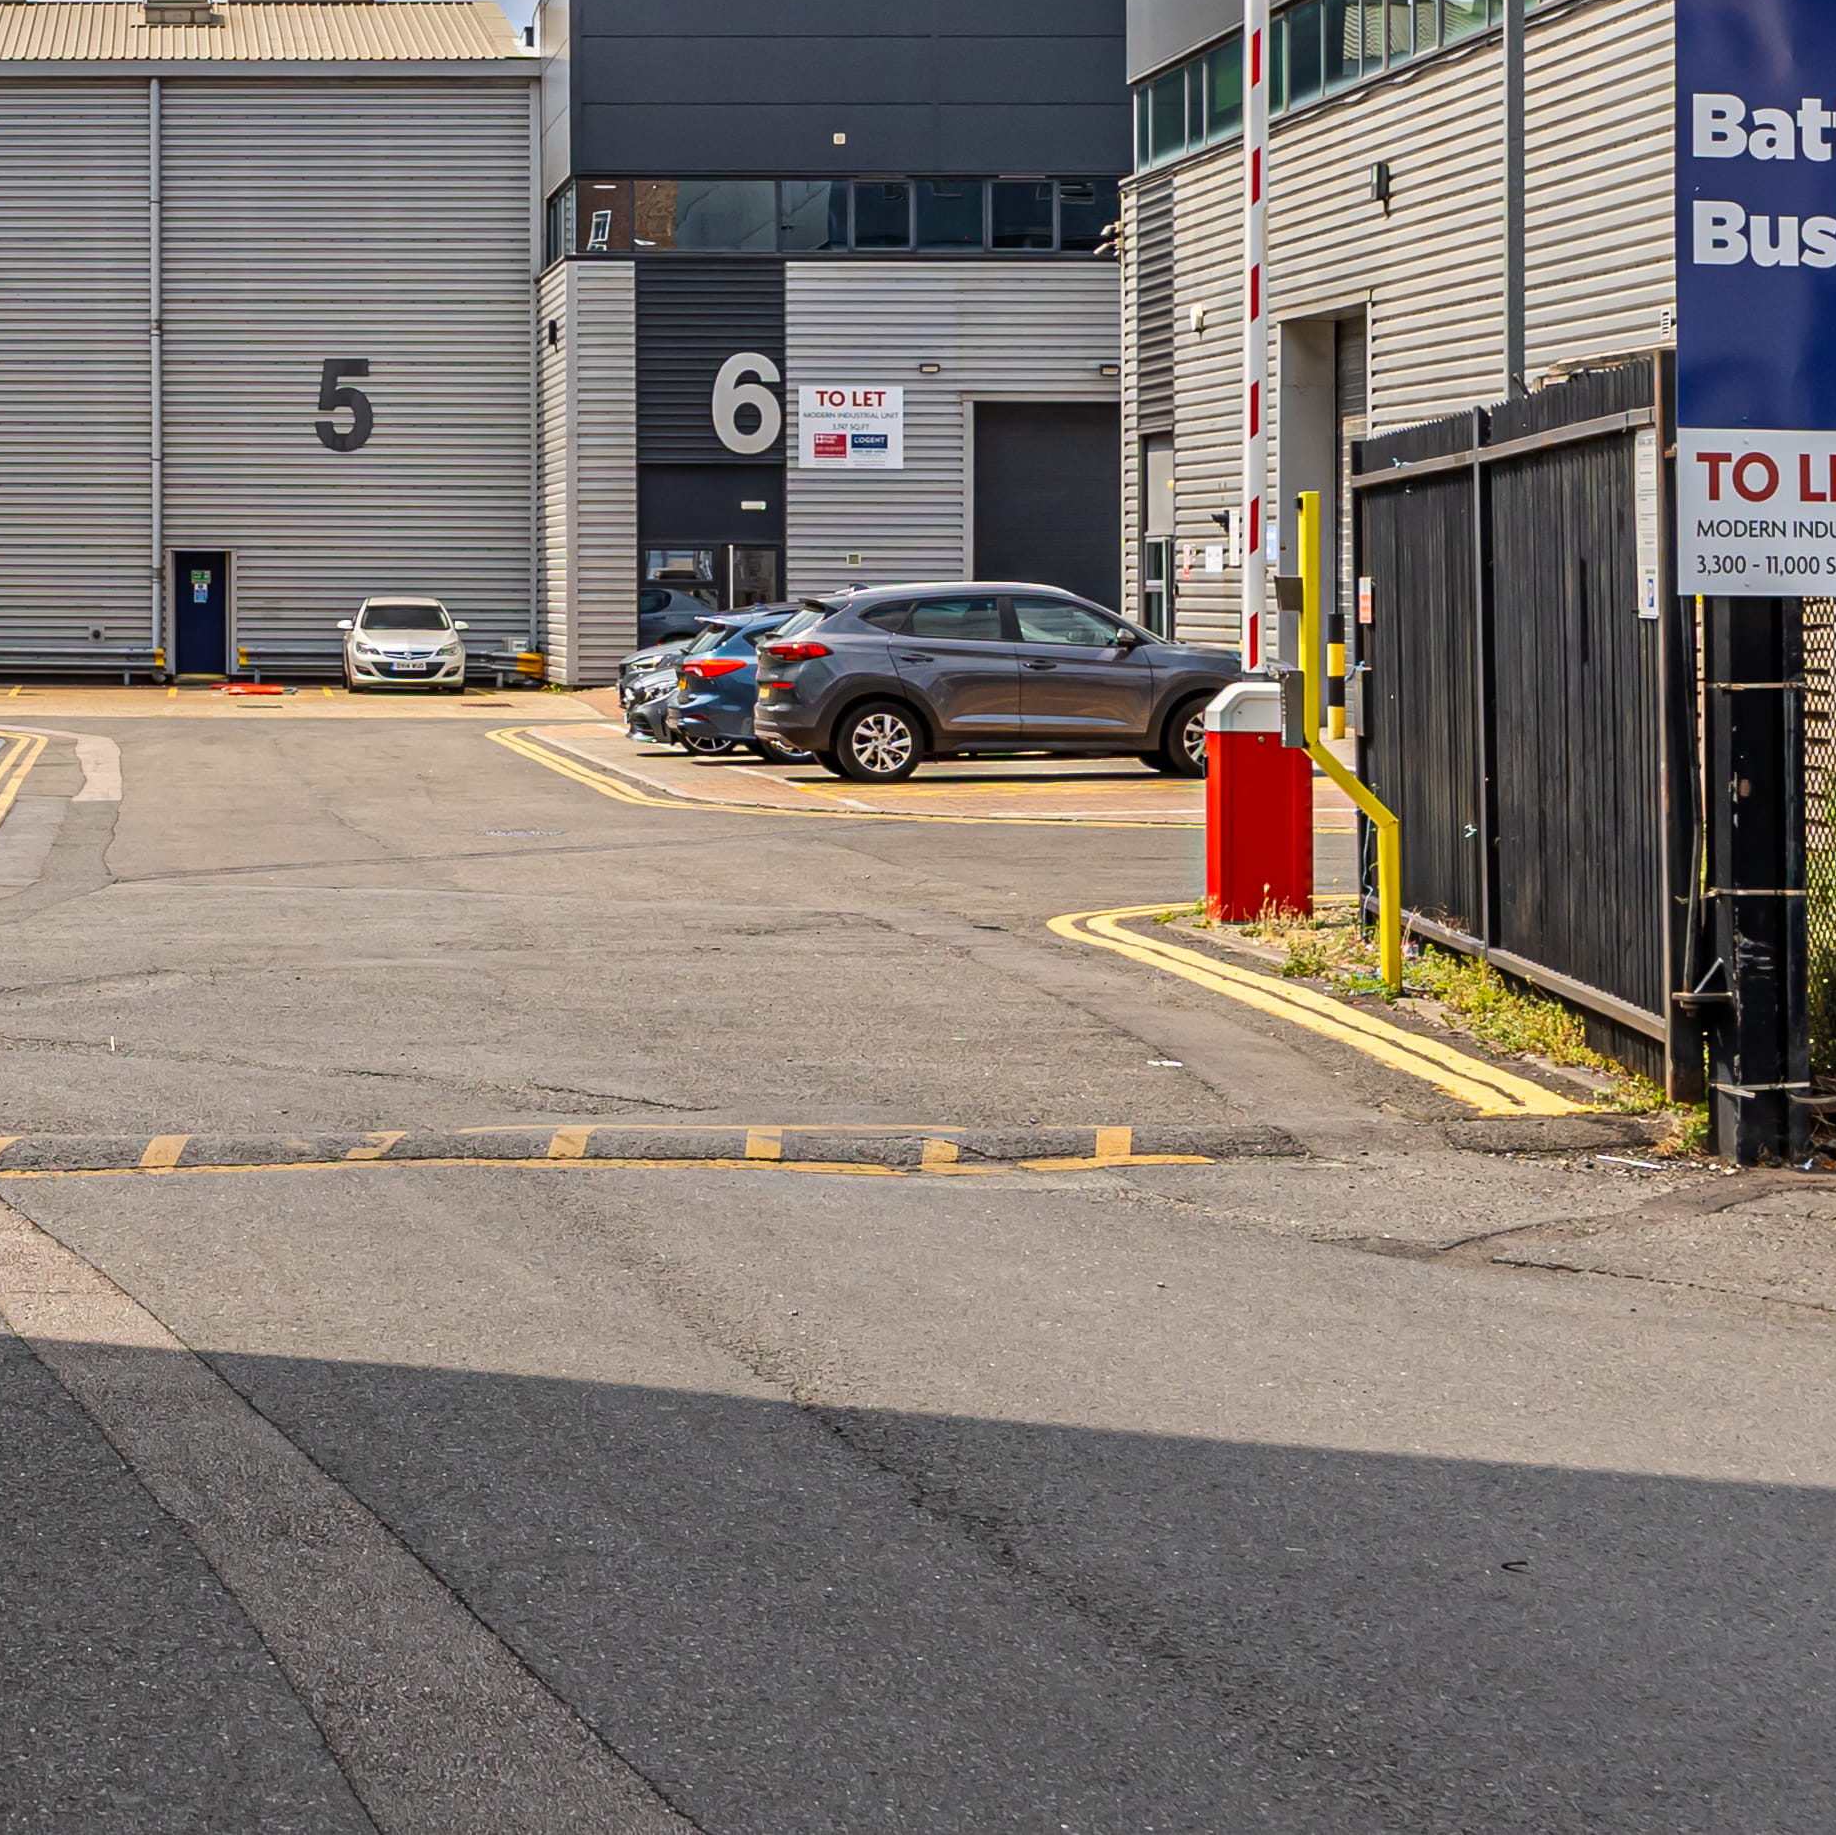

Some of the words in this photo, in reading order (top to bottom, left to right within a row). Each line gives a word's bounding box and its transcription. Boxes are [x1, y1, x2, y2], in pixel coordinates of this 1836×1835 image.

[315, 358, 373, 452] 5
[712, 352, 781, 455] 6
[815, 390, 845, 407] TO
[852, 391, 886, 407] LET
[1696, 452, 1780, 502] TO
[1696, 519, 1786, 538] MODERN
[1696, 555, 1746, 576] 3,300
[1765, 555, 1820, 577] 11,000
